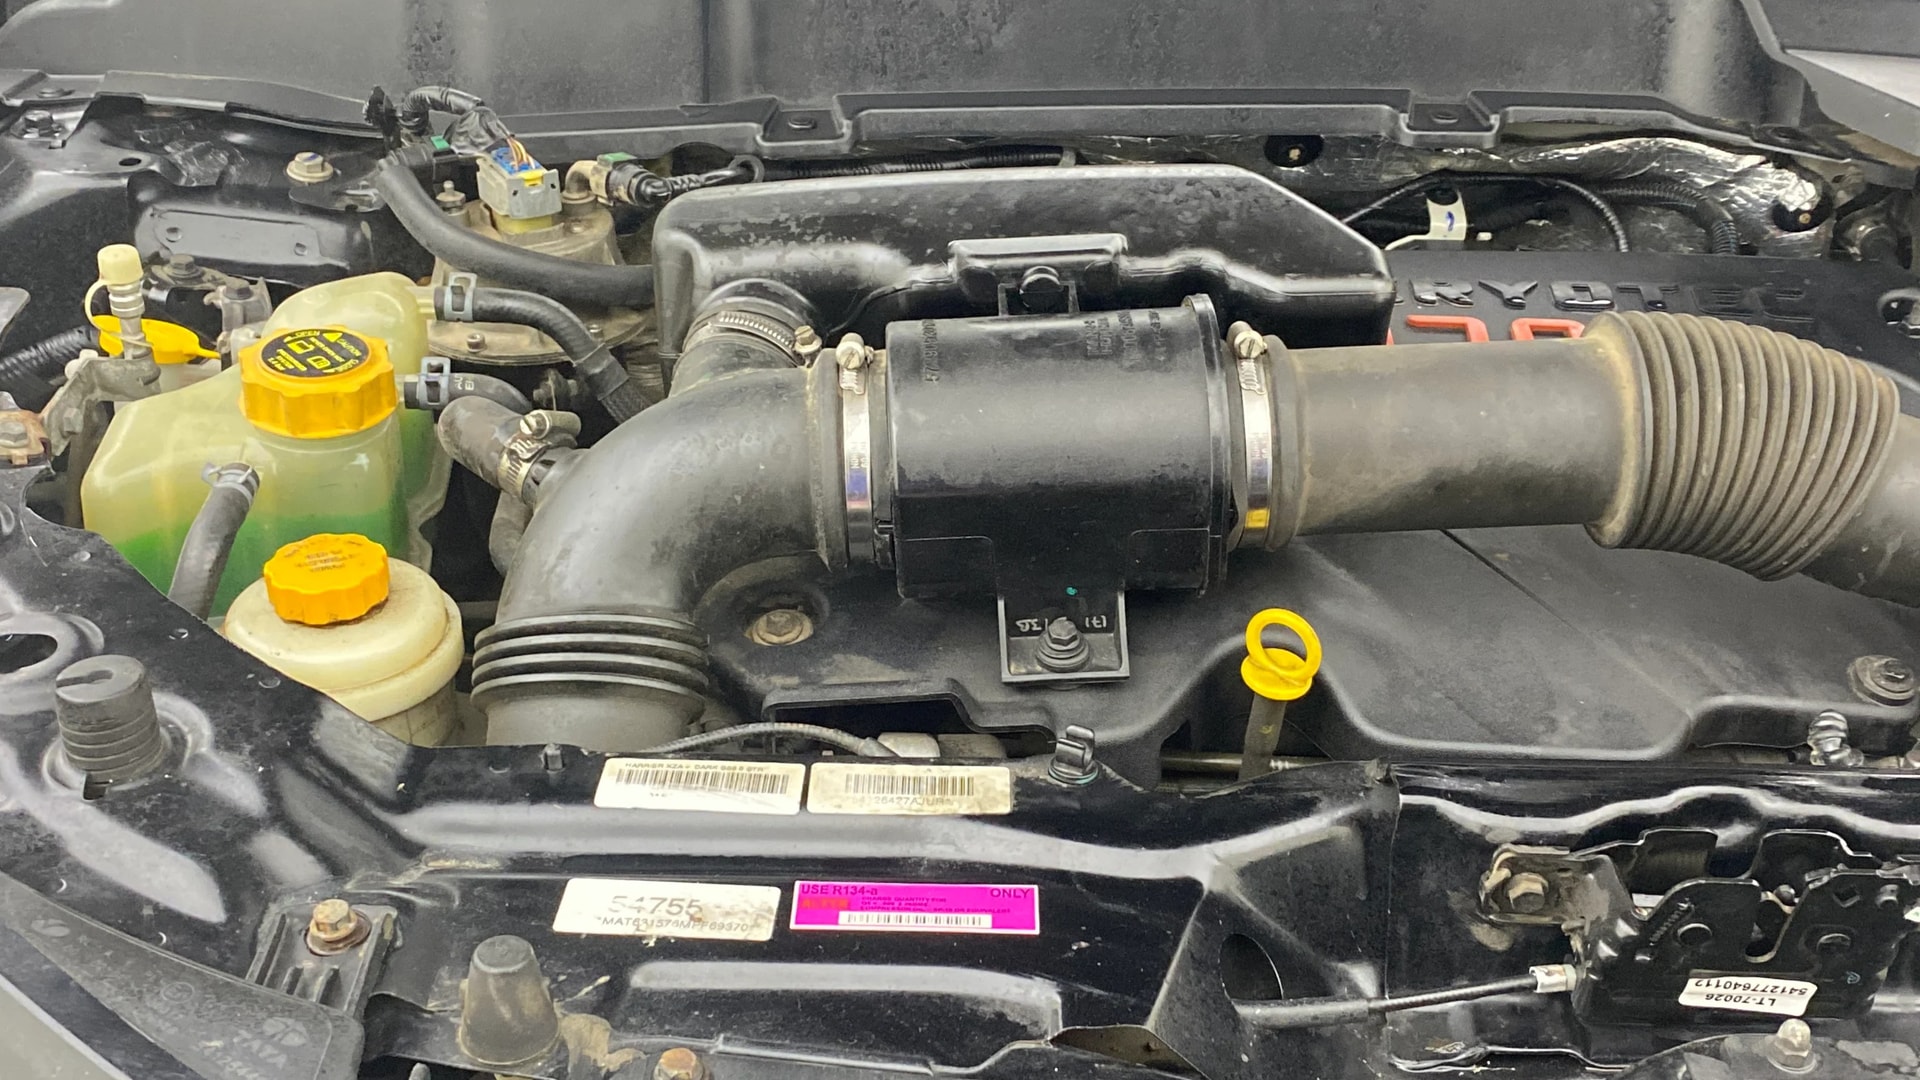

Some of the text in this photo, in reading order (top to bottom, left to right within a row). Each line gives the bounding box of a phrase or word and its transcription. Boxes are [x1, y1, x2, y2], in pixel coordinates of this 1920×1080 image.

[801, 884, 1031, 899] USE R134-a ONLY
[608, 895, 703, 917] 54755
[1694, 979, 1809, 996] 541277640112
[1704, 993, 1777, 1007] LT-70026
